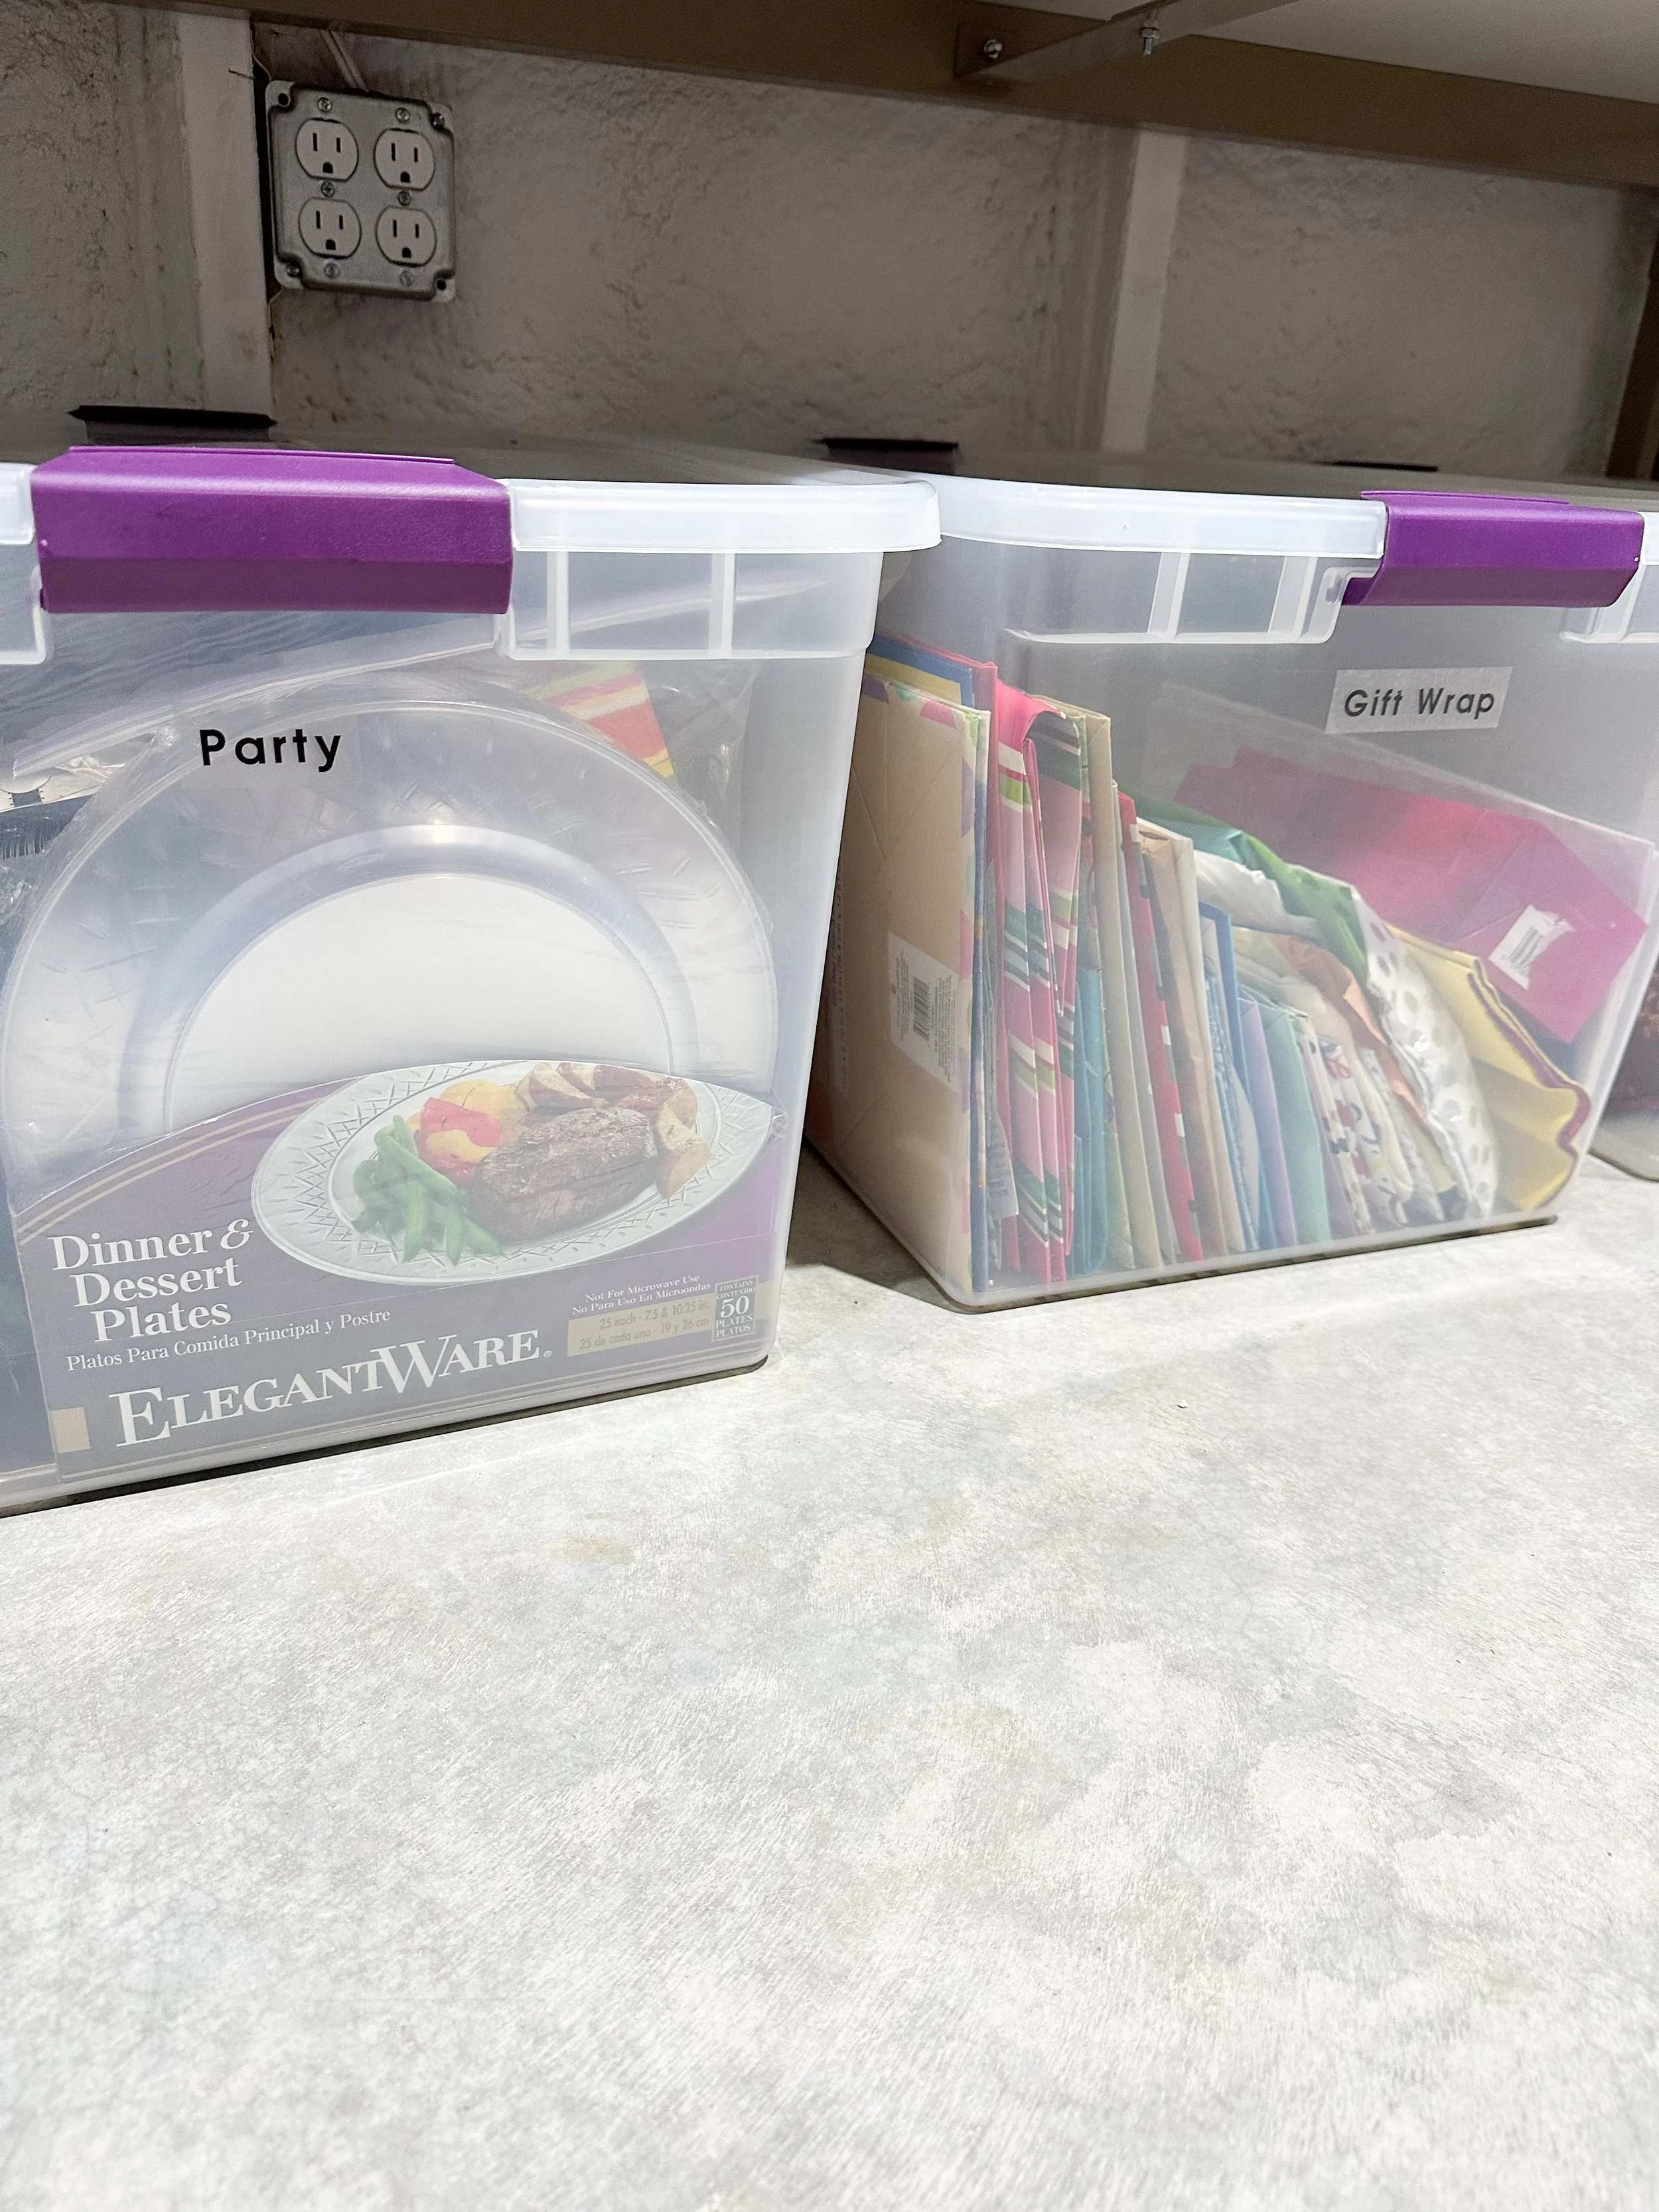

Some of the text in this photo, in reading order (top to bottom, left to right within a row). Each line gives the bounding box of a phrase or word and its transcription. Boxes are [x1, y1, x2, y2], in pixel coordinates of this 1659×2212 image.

[1344, 688, 1494, 719] Gift Wrap
[200, 729, 342, 773] Party
[48, 1218, 255, 1270] Dinner &
[70, 1256, 243, 1307] Dessert
[585, 1275, 700, 1303] Not For Microwave Use
[717, 1286, 756, 1299] CONTENIDO
[720, 1279, 754, 1291] CONTAINS
[572, 1282, 711, 1314] No Para Uso En Microondas
[721, 1295, 750, 1318] 50
[90, 1301, 232, 1343] Plates
[599, 1317, 611, 1330] 25
[614, 1312, 636, 1327] each
[673, 1301, 696, 1315] 10.25
[716, 1314, 753, 1329] PLATES
[716, 1324, 751, 1338] PLATOS
[67, 1309, 391, 1370] Platos Para Comida Principal y Postre
[580, 1337, 592, 1349] 25
[595, 1335, 606, 1347] de
[609, 1331, 632, 1344] cada
[634, 1329, 651, 1339] uno
[661, 1322, 671, 1334] 19
[682, 1319, 691, 1330] 26
[697, 1318, 709, 1327] cm
